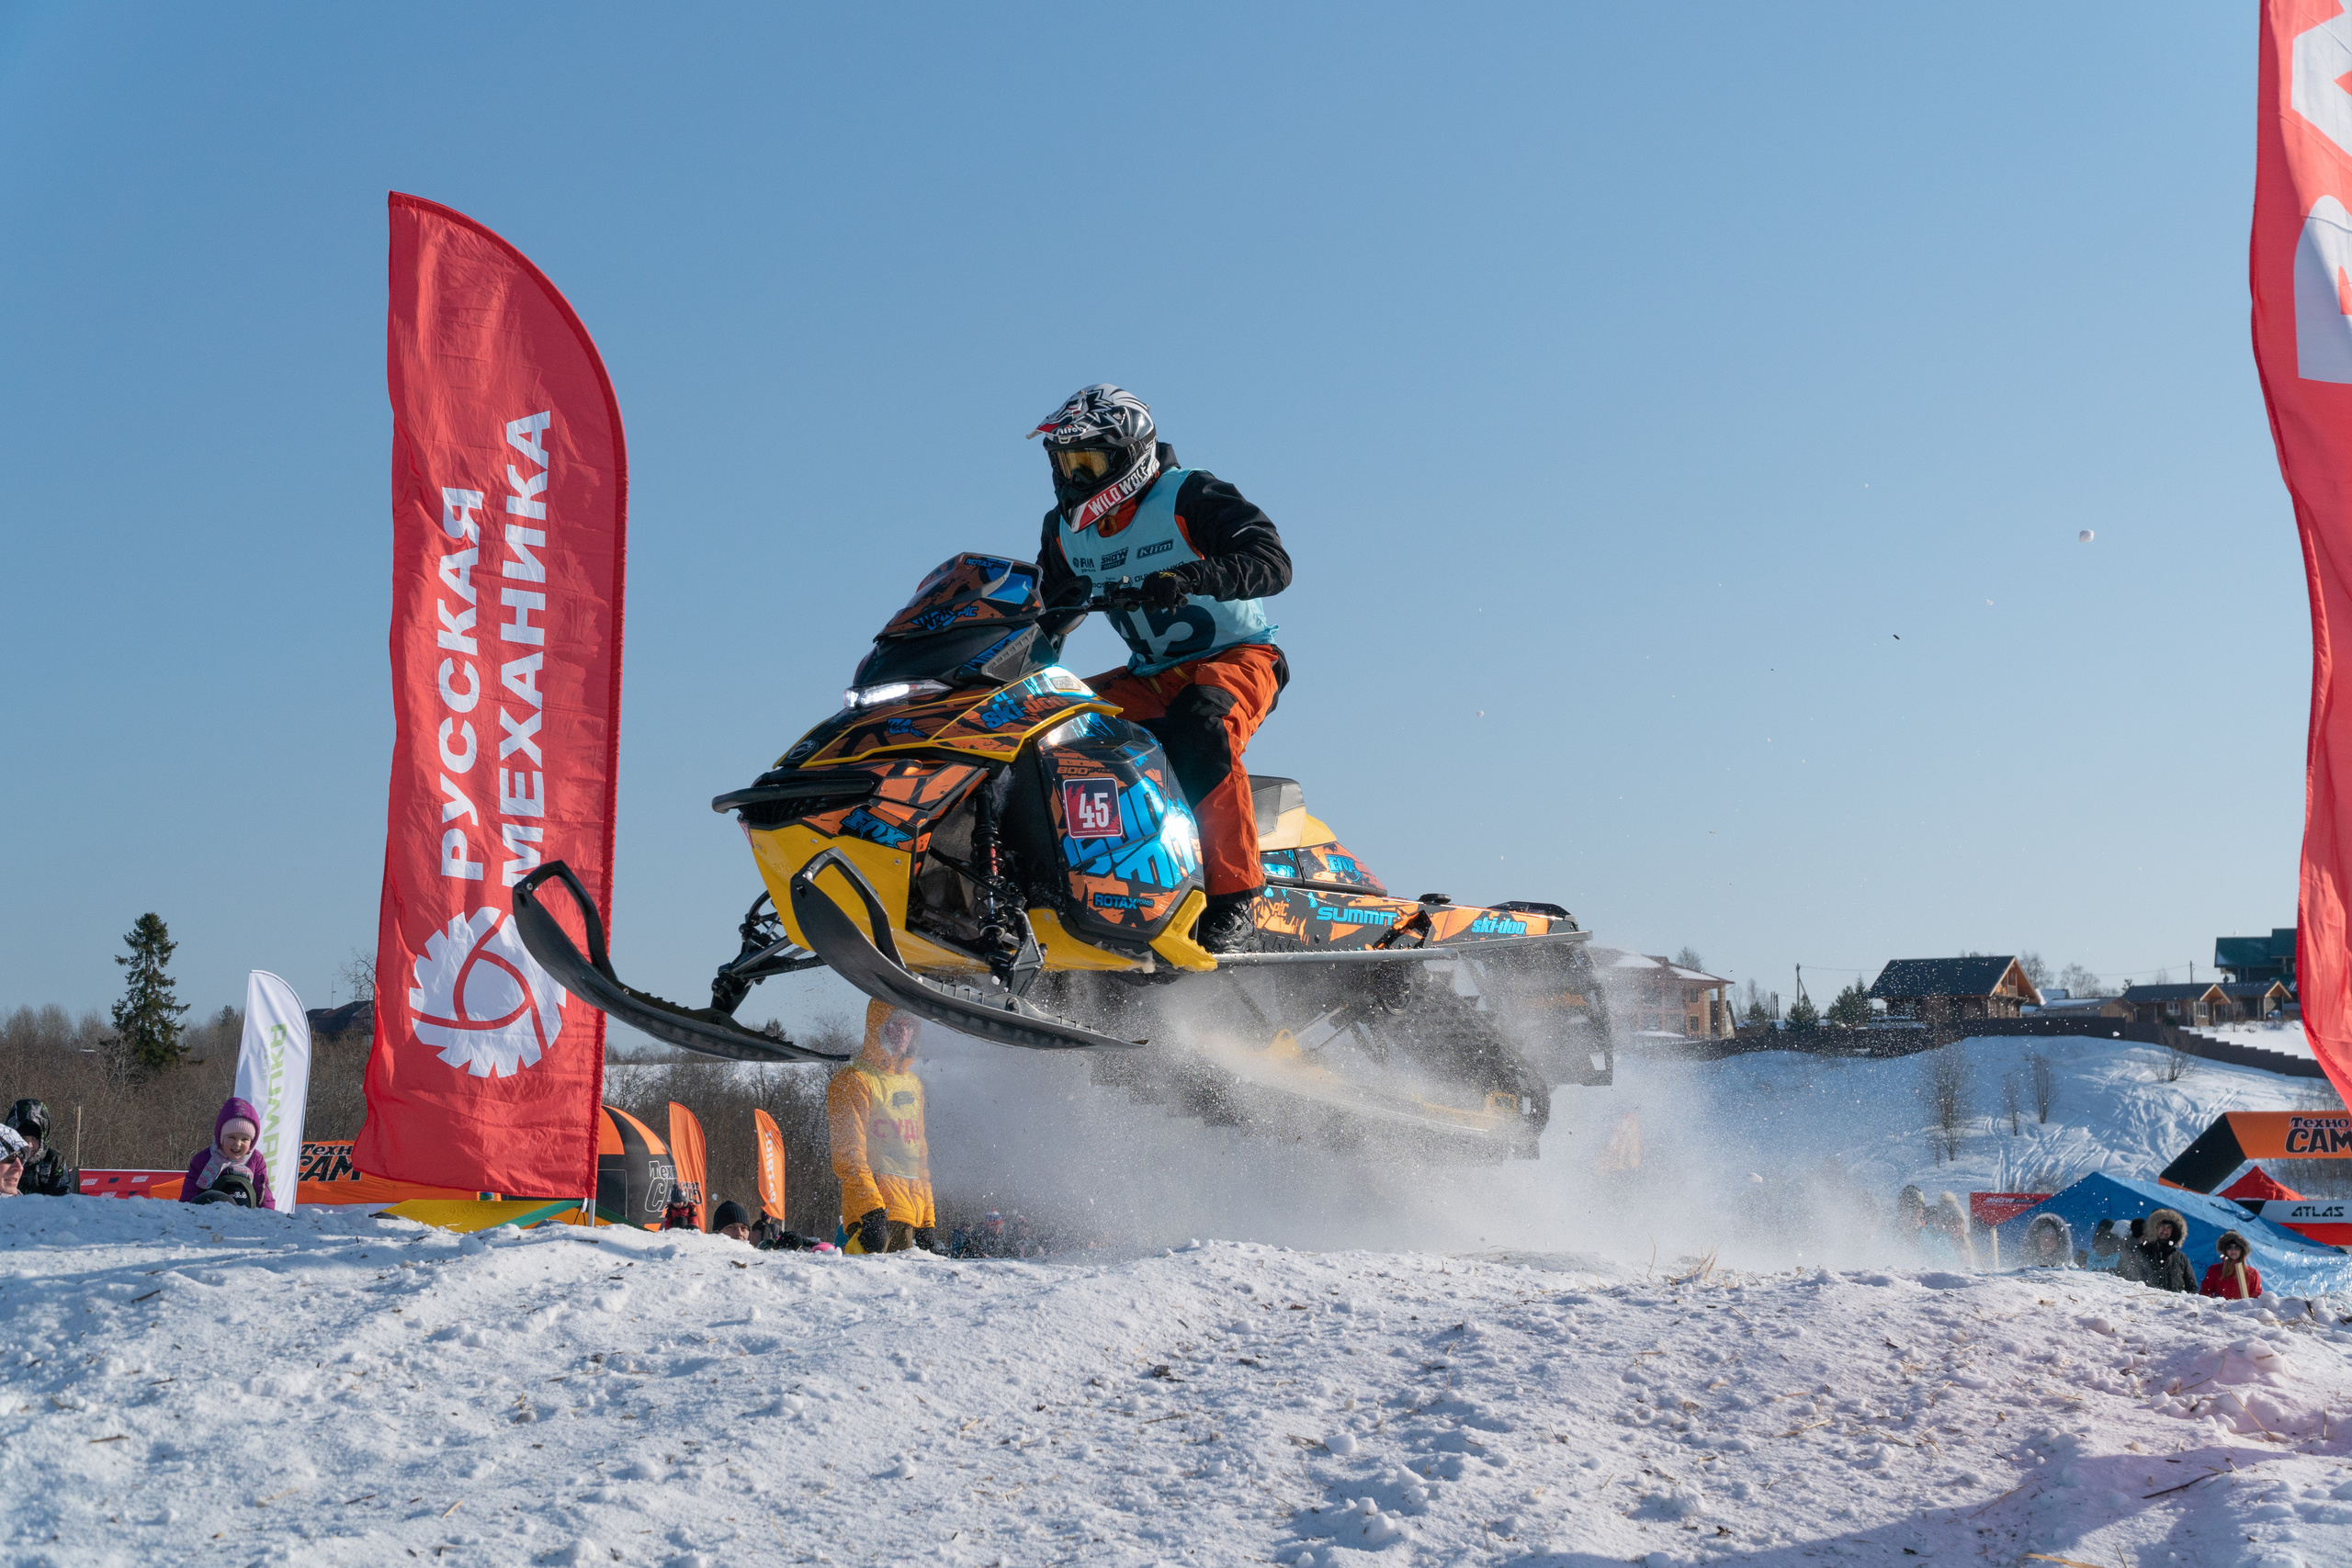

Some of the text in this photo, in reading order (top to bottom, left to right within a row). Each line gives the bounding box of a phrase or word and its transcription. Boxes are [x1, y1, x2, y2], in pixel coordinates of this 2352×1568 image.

[1088, 465, 1149, 516] WILD WOLF
[965, 558, 993, 570] ROTAX
[497, 410, 552, 889] МЕХАНИКА
[436, 486, 485, 883] РУССКАЯ
[980, 694, 1069, 729] ski-doo
[1056, 766, 1089, 775] 800
[1079, 792, 1110, 829] 45
[842, 808, 913, 849] FOX
[1326, 854, 1357, 874] FOX
[1094, 894, 1155, 910] ROTAX POWER
[1316, 906, 1397, 926] SUMMIT
[1471, 917, 1527, 935] ski-doo
[2289, 1116, 2350, 1129] Техно
[300, 1143, 354, 1156] Техн
[2285, 1128, 2352, 1154] САМ
[2290, 1206, 2345, 1217] ATLAS
